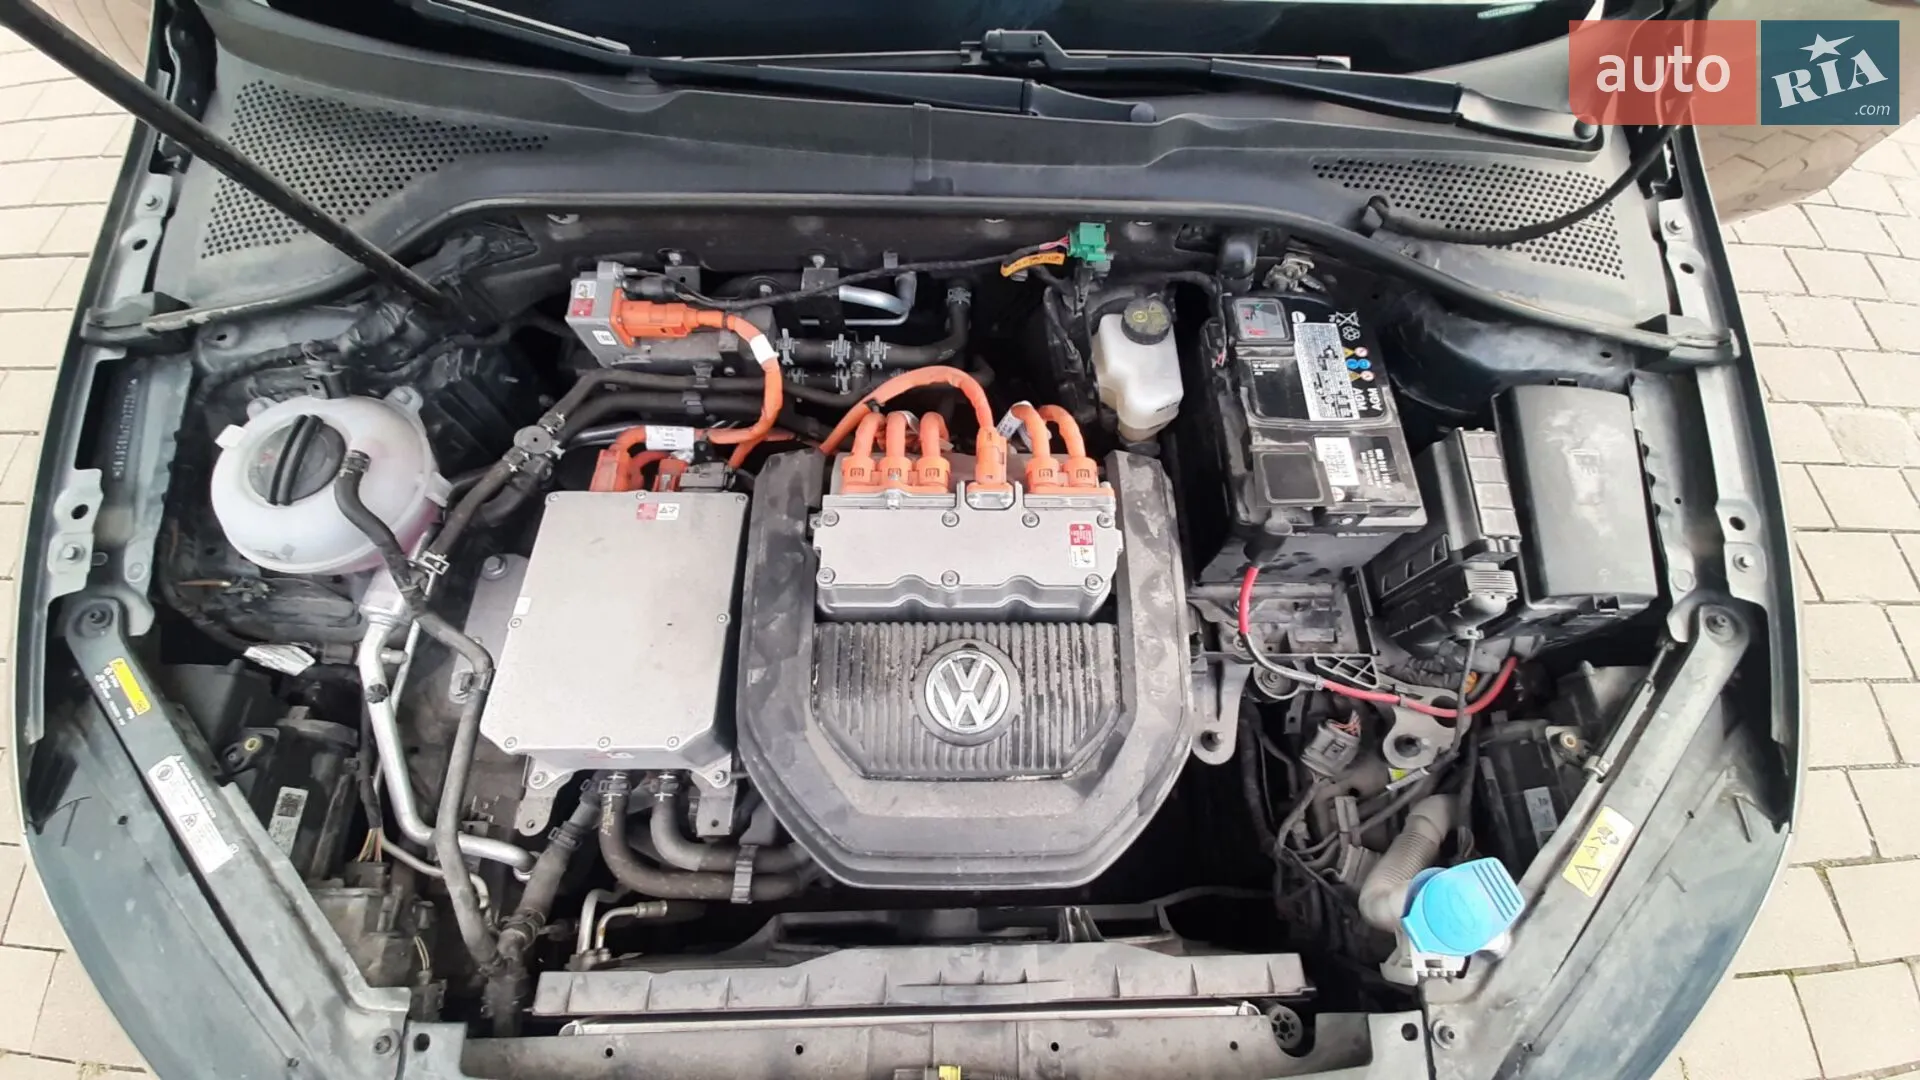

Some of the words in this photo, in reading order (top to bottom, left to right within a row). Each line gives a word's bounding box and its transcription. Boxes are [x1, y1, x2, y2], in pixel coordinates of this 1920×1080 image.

[1353, 387, 1368, 410] AGM
[1366, 387, 1383, 410] AGM
[928, 652, 1008, 732] VW
